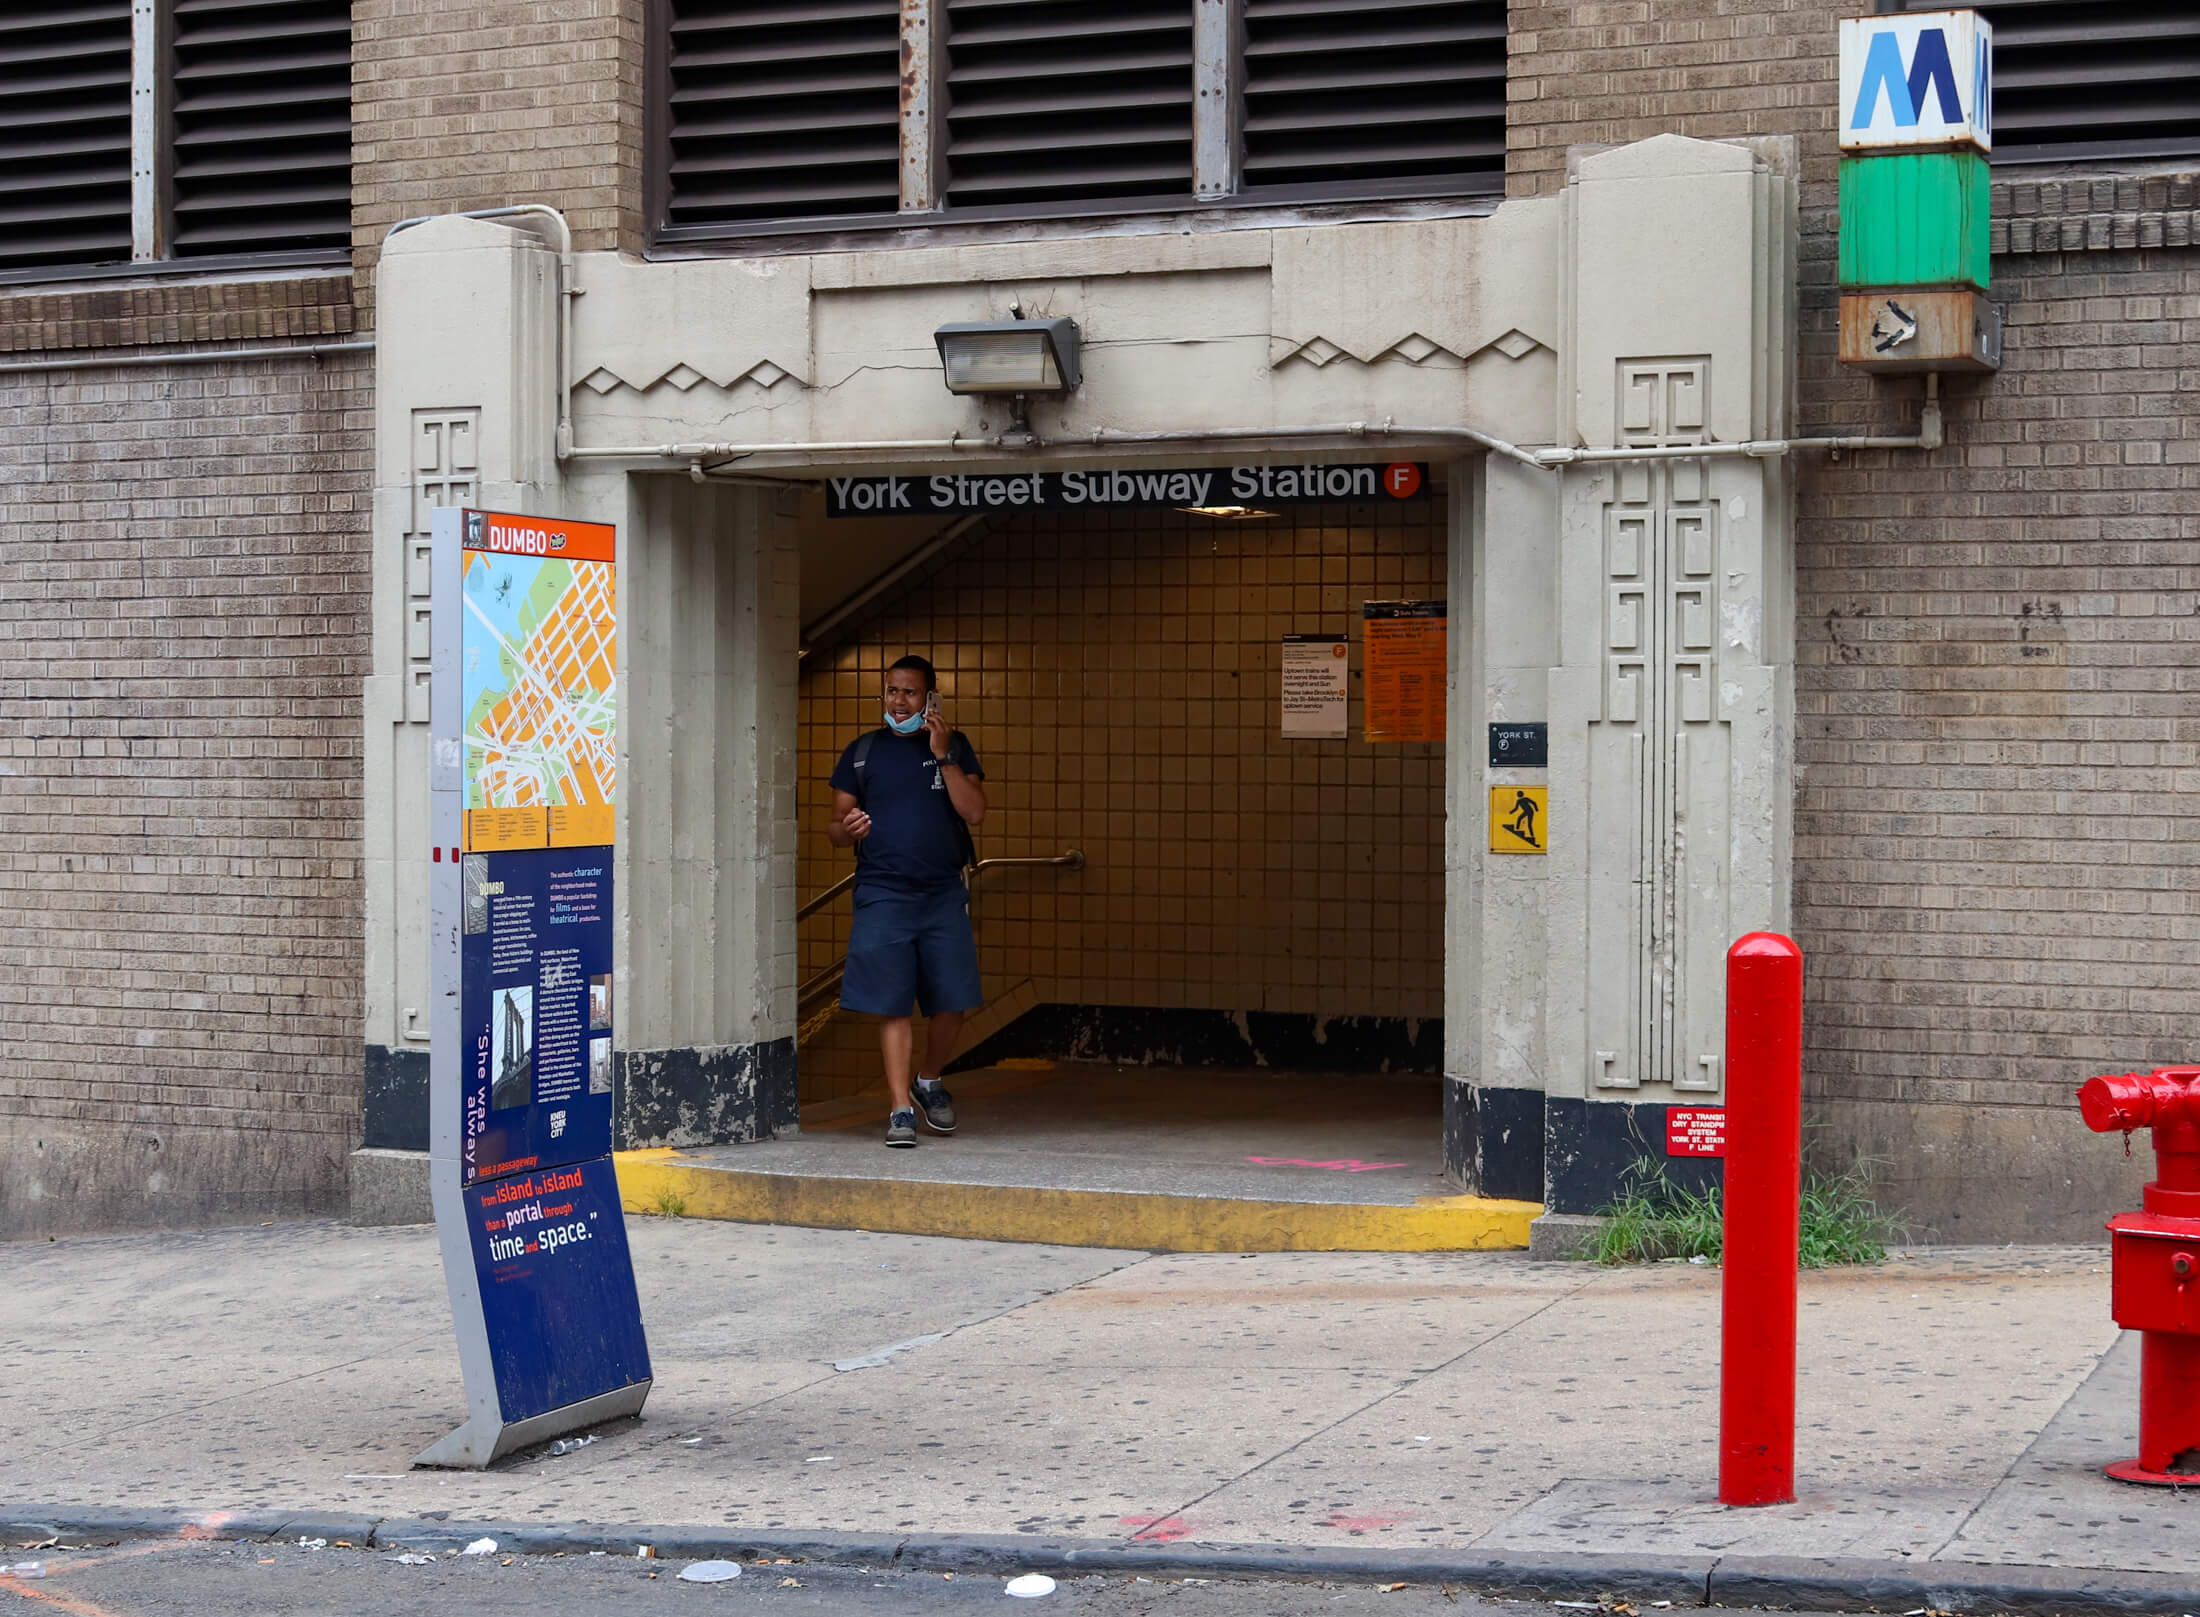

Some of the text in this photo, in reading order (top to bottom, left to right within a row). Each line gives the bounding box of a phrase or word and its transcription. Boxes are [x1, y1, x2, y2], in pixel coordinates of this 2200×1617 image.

[830, 464, 1410, 510] York Street Subway Station F
[490, 526, 547, 554] DUMBO
[1498, 731, 1536, 740] YORK ST.
[574, 867, 603, 877] character
[480, 881, 504, 896] DUMBO
[556, 903, 571, 913] films
[550, 913, 579, 924] theatrical
[477, 1086, 487, 1134] was
[1677, 1112, 1693, 1120] NYC
[550, 1117, 567, 1129] YORK
[1672, 1120, 1688, 1128] DRY
[550, 1127, 564, 1139] CITY
[1687, 1128, 1717, 1136] SYSTEM
[1670, 1135, 1690, 1143] YORK
[1689, 1143, 1716, 1152] F LINE
[496, 1155, 539, 1175] passageway
[481, 1167, 584, 1207] from island to island
[485, 1218, 501, 1232] than
[506, 1199, 544, 1231] portal
[543, 1202, 573, 1218] through
[489, 1234, 525, 1262] time
[525, 1240, 539, 1254] and
